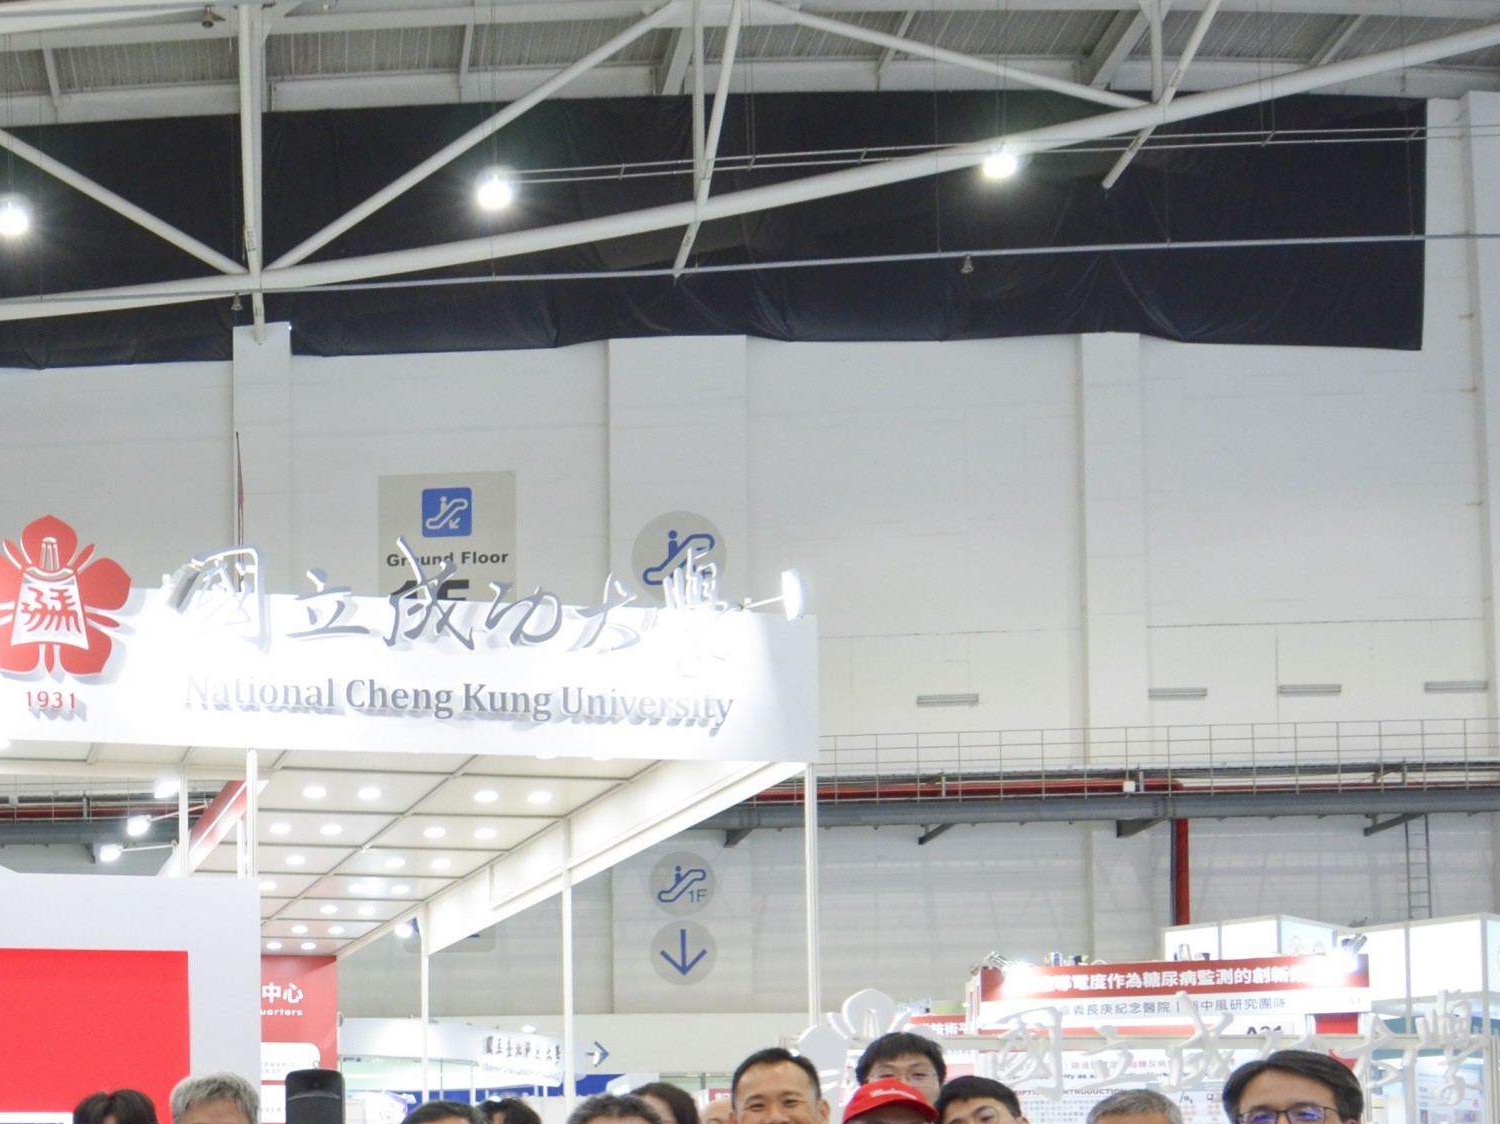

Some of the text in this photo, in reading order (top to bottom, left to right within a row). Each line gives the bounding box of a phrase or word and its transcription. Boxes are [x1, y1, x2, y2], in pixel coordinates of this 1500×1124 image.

[386, 551, 509, 567] Grund Floor
[25, 690, 77, 712] 1931
[186, 672, 734, 727] National Cheng Kung University
[688, 889, 707, 902] 1F
